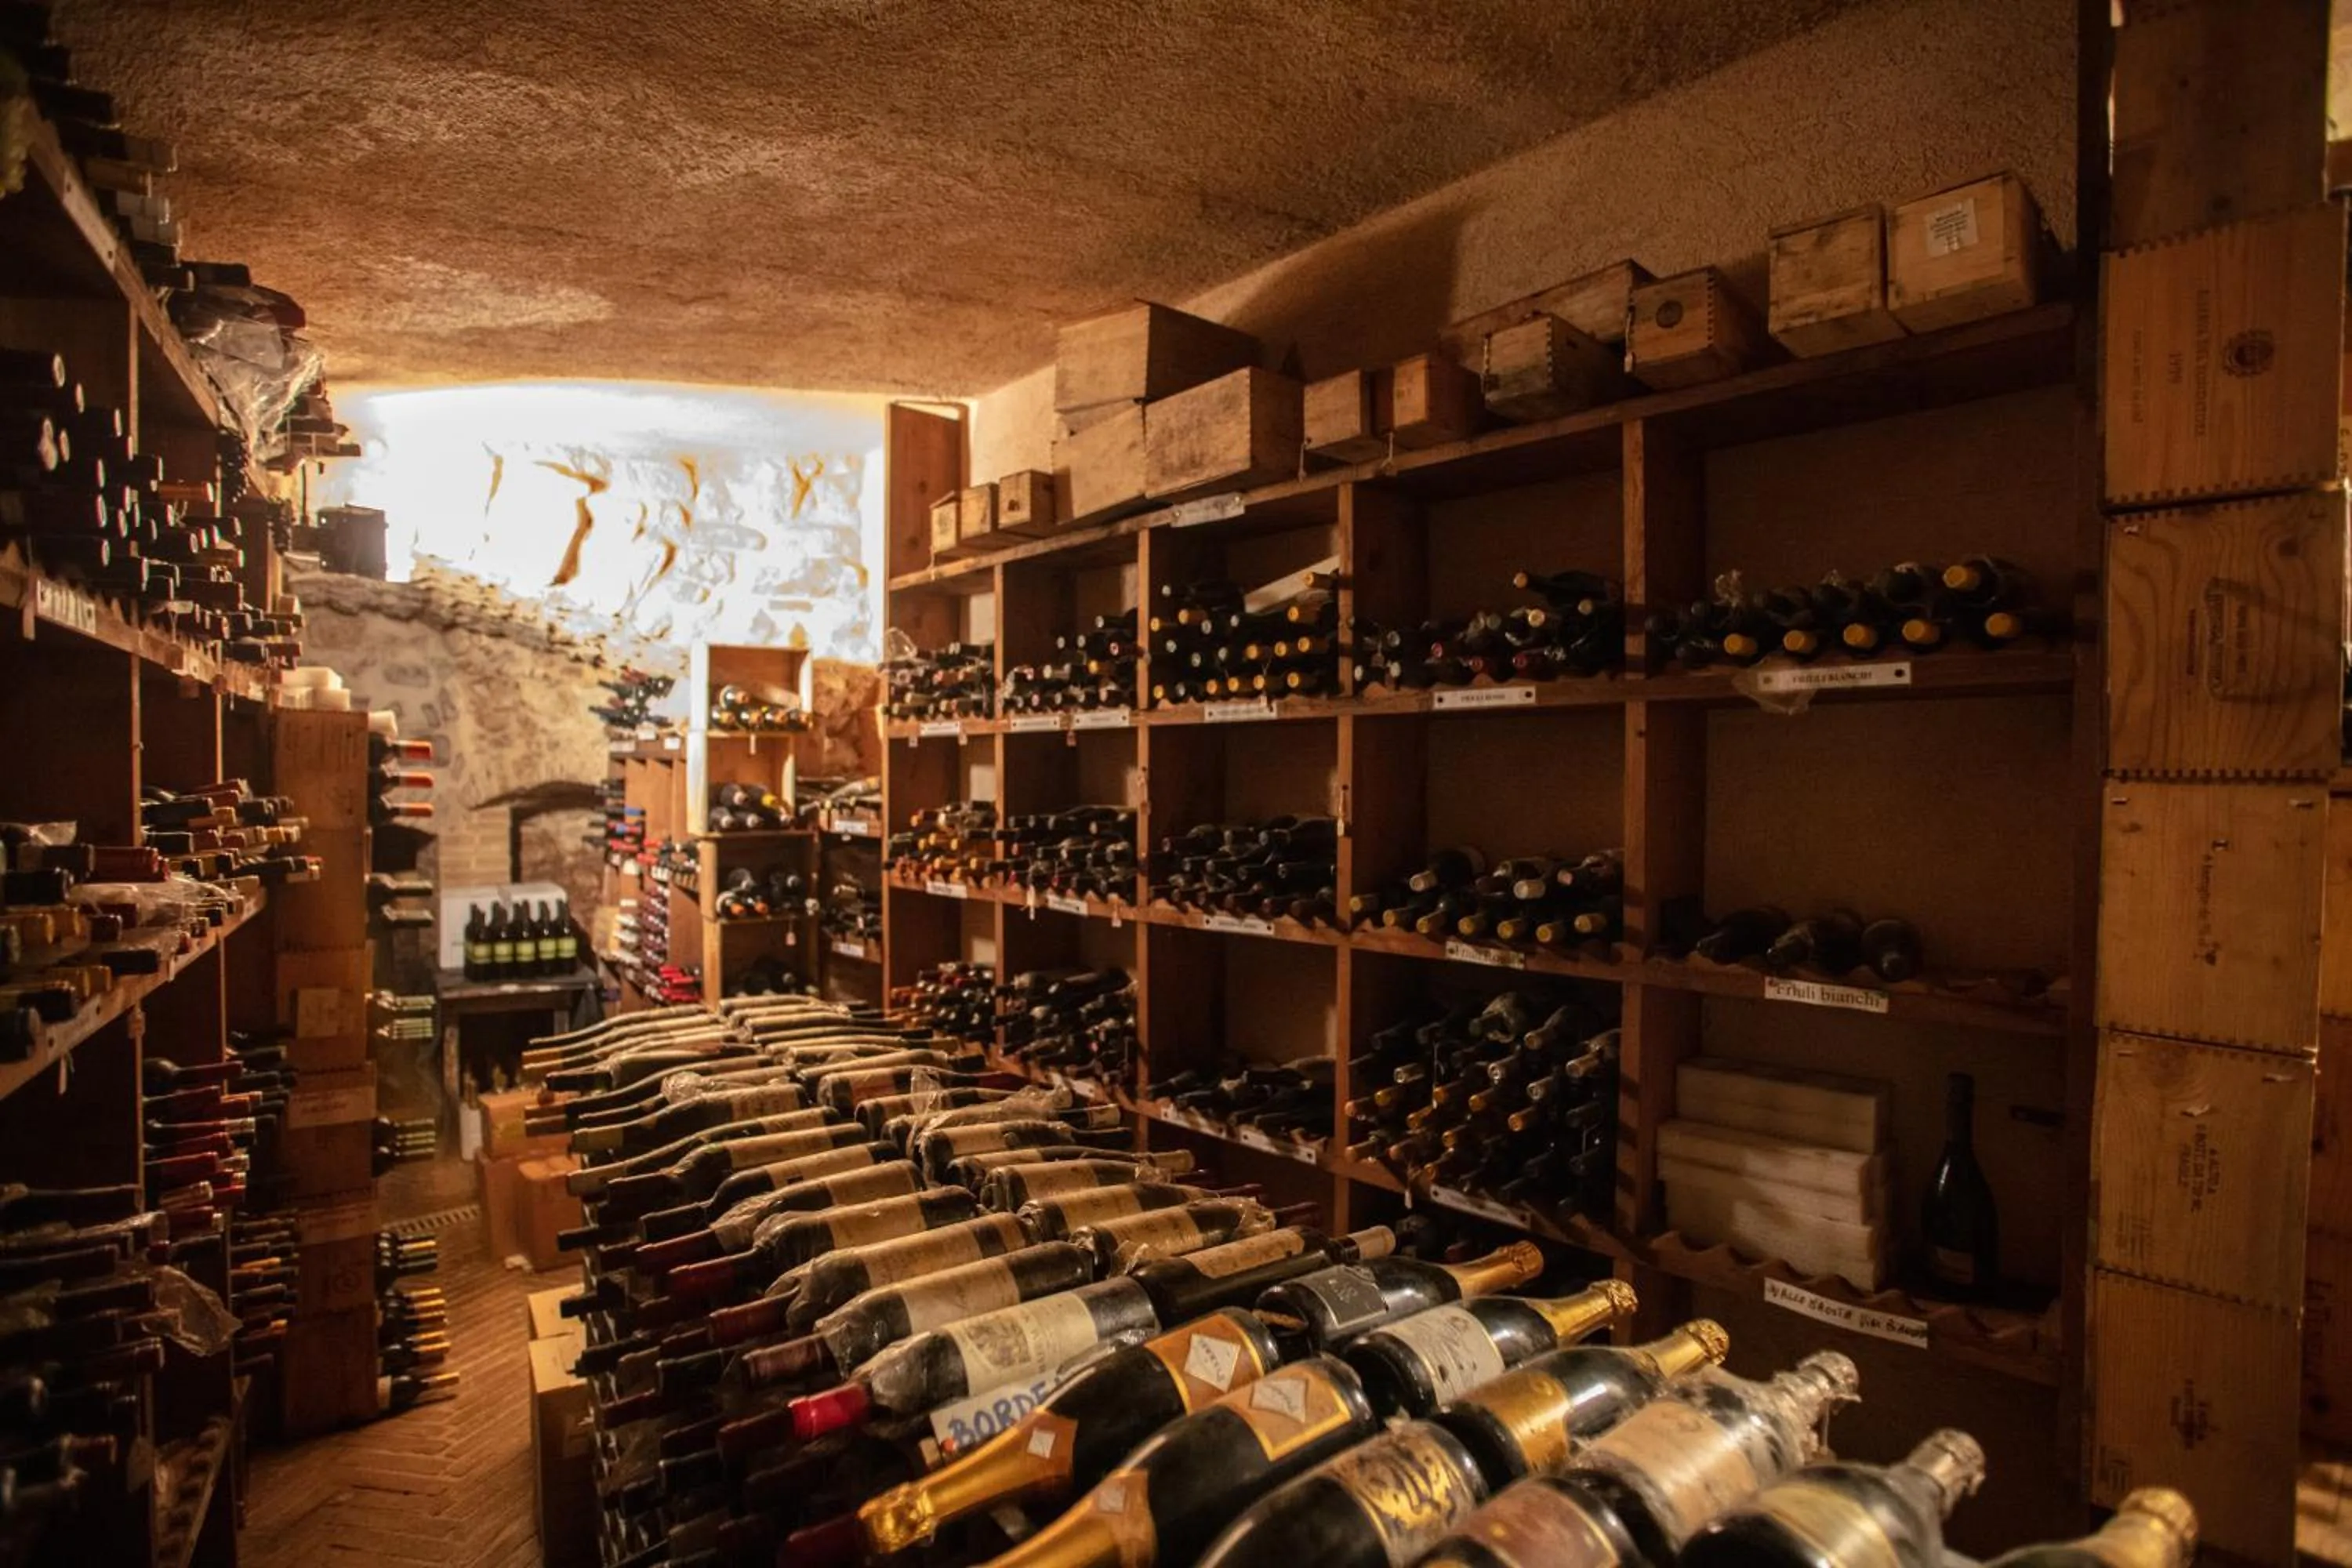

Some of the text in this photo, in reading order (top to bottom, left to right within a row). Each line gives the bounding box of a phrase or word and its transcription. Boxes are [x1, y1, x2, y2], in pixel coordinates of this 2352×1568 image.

[1776, 982, 1880, 1007] Friuli bianchi
[949, 1377, 1060, 1446] BORDE
